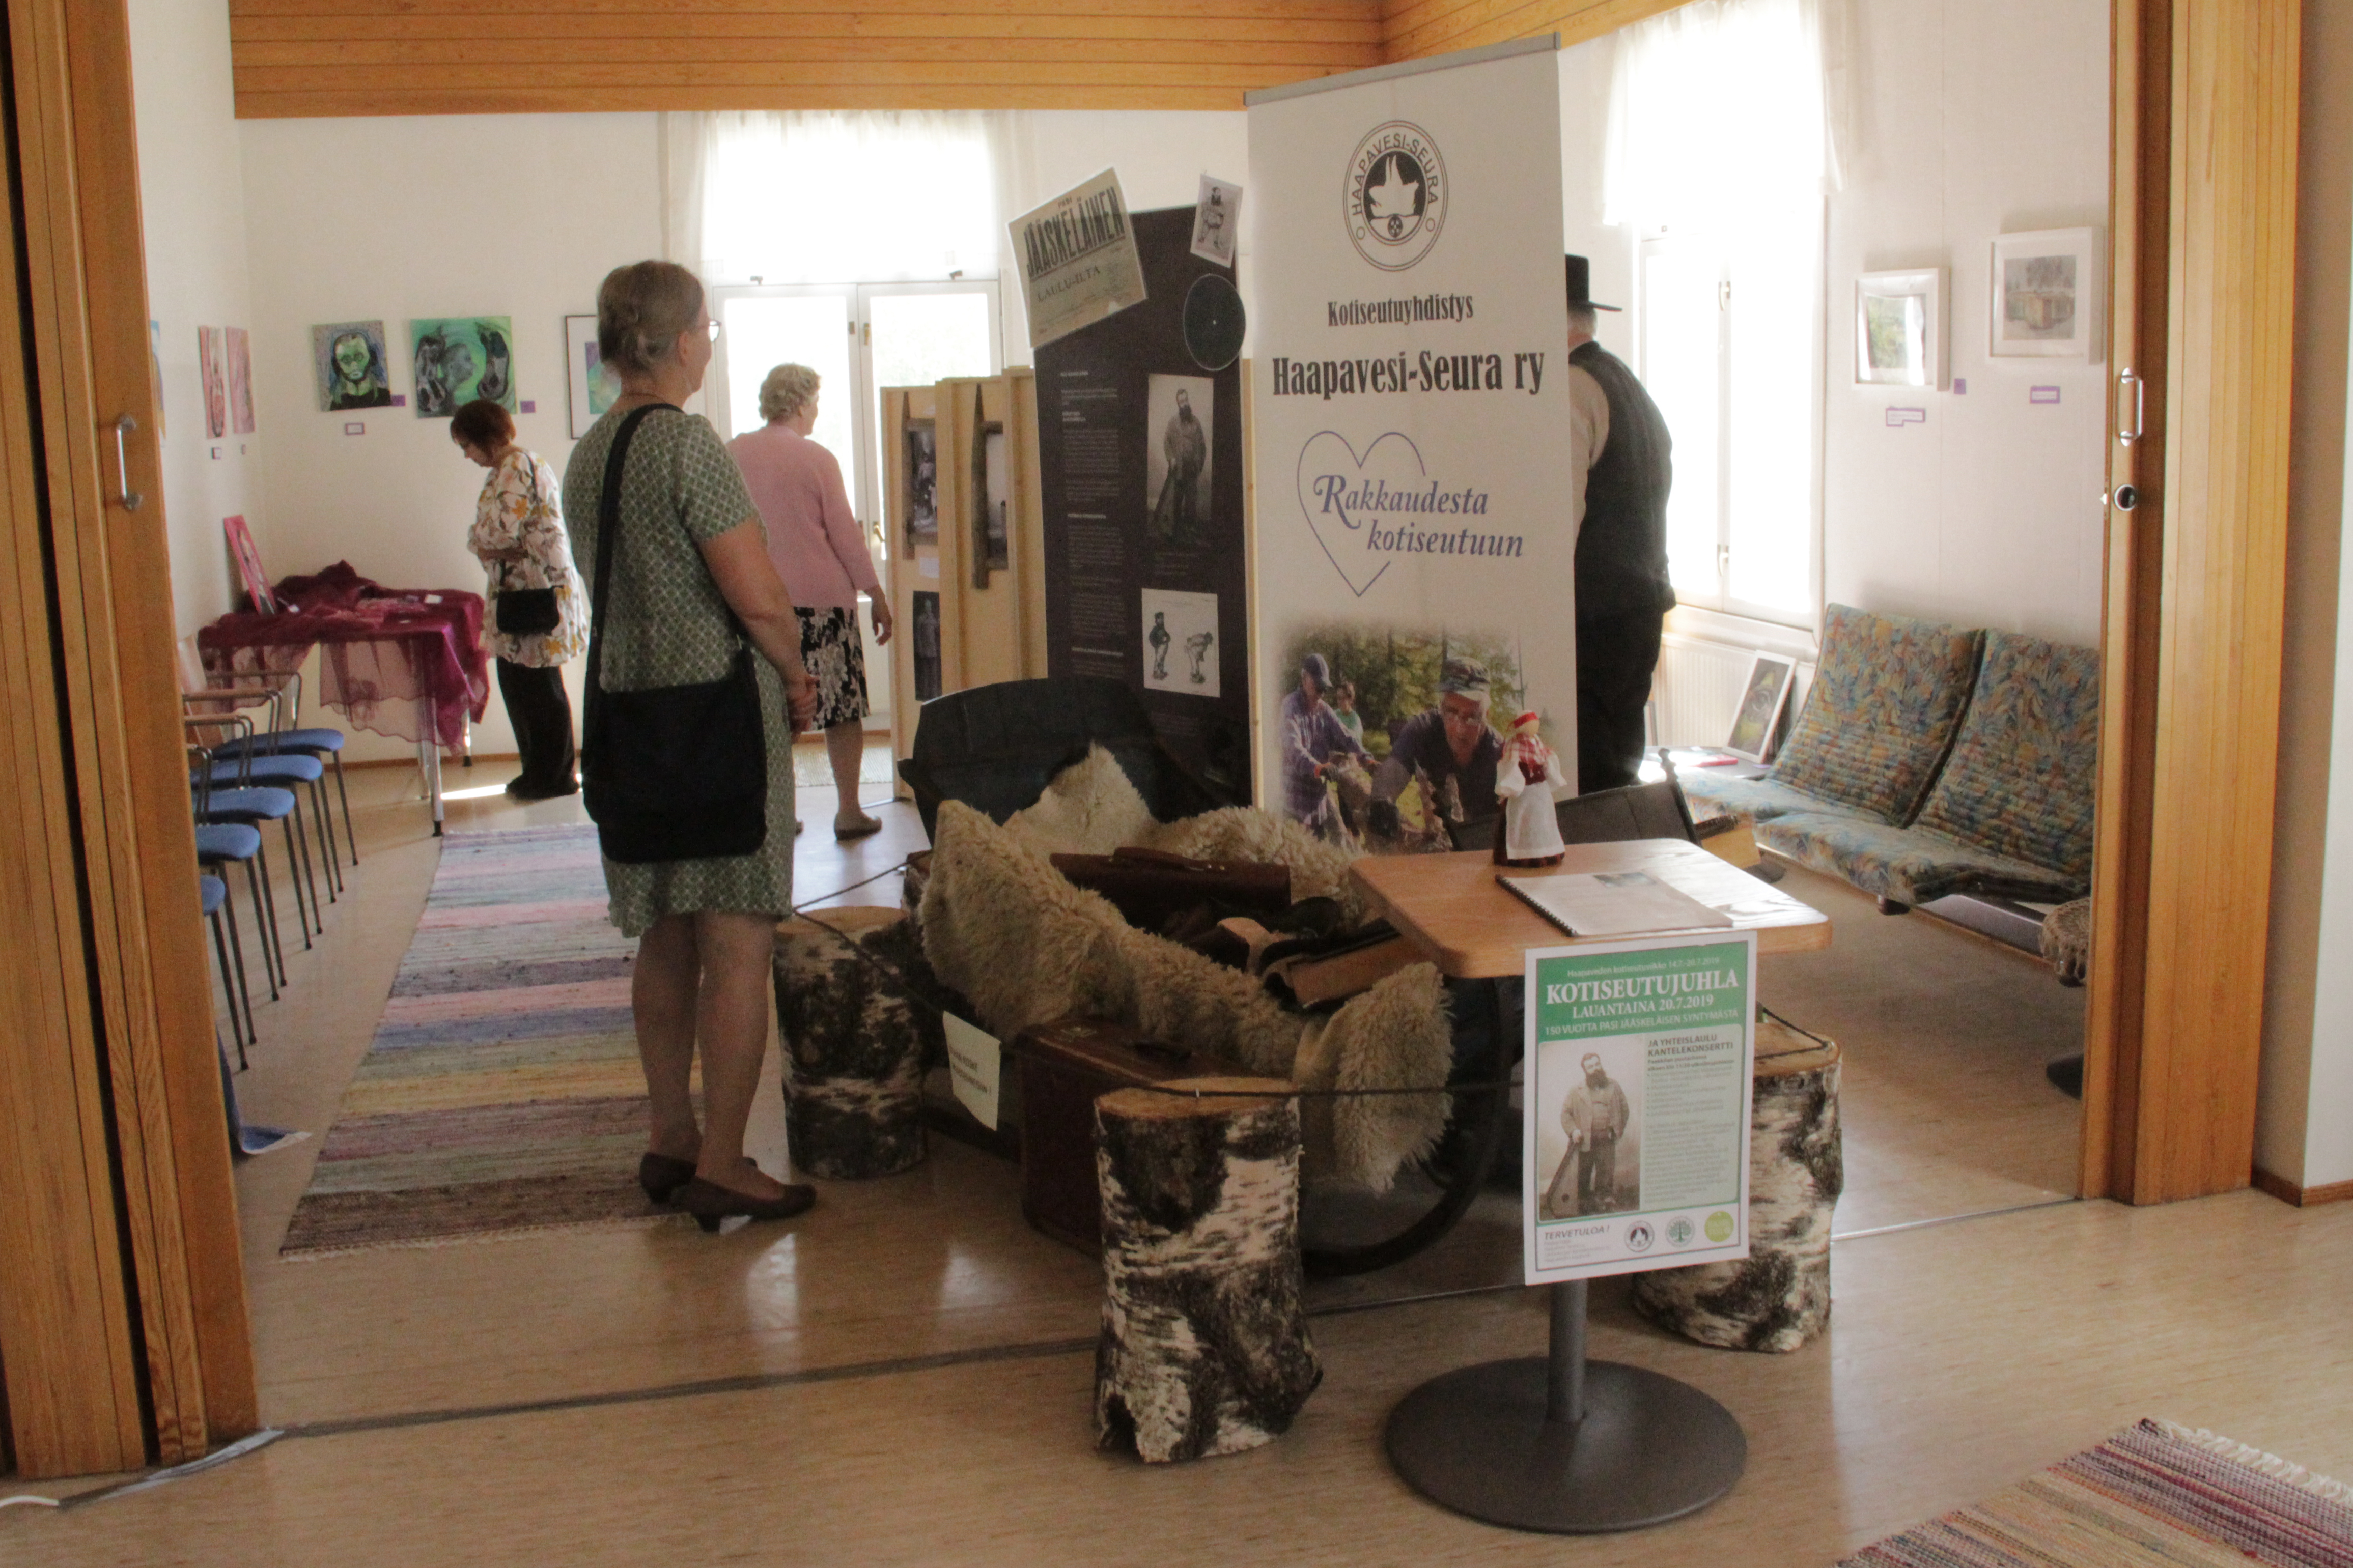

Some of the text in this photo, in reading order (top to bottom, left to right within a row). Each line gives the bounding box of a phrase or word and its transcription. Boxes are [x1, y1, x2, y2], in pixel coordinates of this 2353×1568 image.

[1351, 133, 1439, 216] HAAPAVESI-SEURA
[1023, 186, 1125, 278] JÄÄSKELÄINEN
[1328, 293, 1473, 326] Kotiseutuyhdistys
[1272, 350, 1544, 400] Haapavesi-Seura ry
[1313, 474, 1488, 529] Rakkaudesta
[1367, 519, 1523, 557] kotiseutuun
[1546, 969, 1739, 1004] KOTISEUTUJUHLA
[1573, 994, 1714, 1019] LAUANTAINA 20.7.2019
[1546, 1026, 1560, 1035] 150
[1562, 1022, 1597, 1034] VUOTTA
[1600, 1019, 1618, 1030] PASI
[1660, 1034, 1717, 1046] YHTEISLAULU
[1648, 1042, 1733, 1057] KANTELEKONSERTTI
[1545, 1225, 1604, 1240] TERVETULOA
